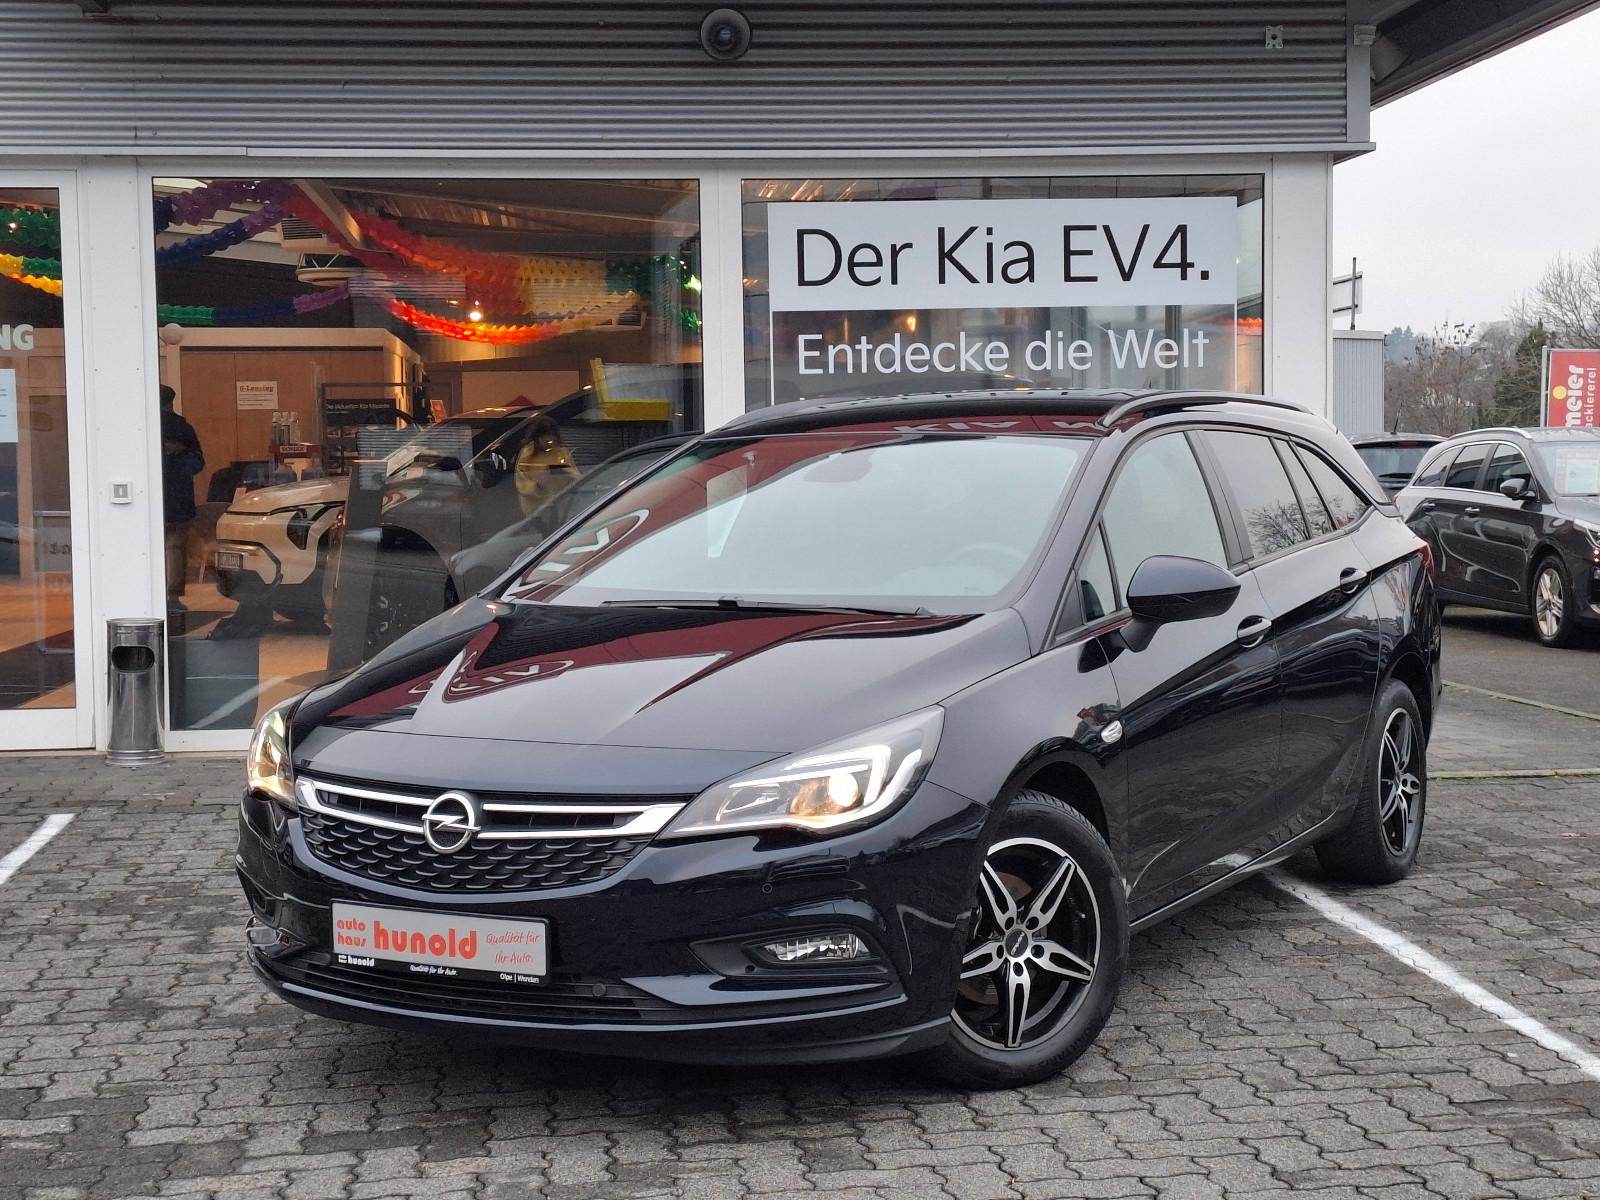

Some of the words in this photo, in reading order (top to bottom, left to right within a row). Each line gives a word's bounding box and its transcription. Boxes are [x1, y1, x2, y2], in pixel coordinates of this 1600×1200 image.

[797, 228, 914, 287] Der
[937, 226, 1035, 284] Kia
[1063, 224, 1210, 283] EV4.
[798, 331, 1010, 375] Entdecke
[1025, 330, 1093, 371] die
[1107, 328, 1210, 369] Welt
[336, 917, 366, 932] auto
[337, 932, 367, 947] haus
[373, 920, 477, 960] hunold
[348, 955, 375, 967] hunold
